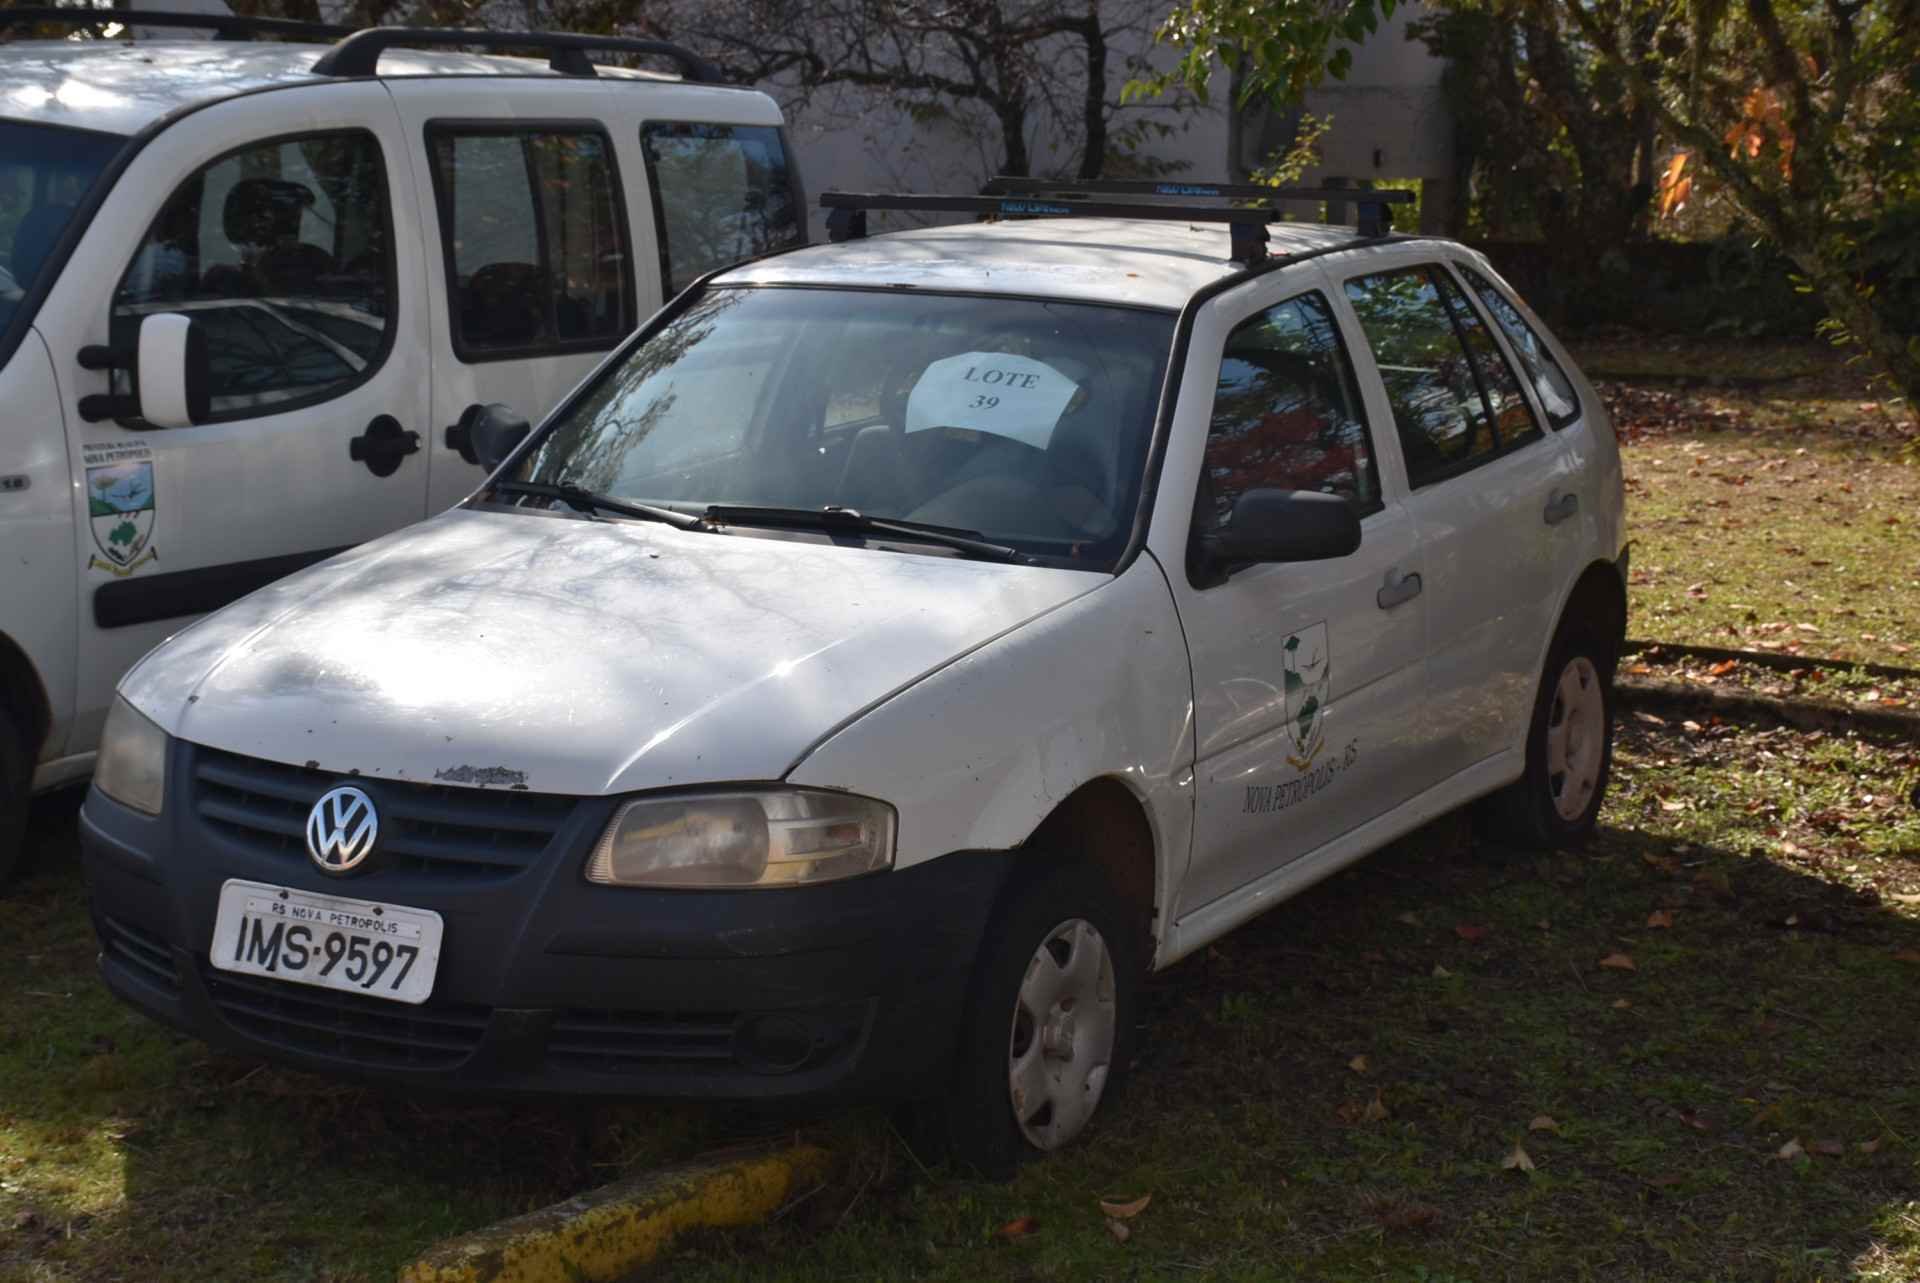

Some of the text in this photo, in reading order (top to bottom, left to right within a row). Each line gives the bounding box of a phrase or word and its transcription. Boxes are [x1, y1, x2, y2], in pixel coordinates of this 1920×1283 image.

[963, 367, 1040, 390] LOTE
[968, 395, 1000, 410] 39
[272, 902, 399, 934] RS NOVA PETROPOLIS
